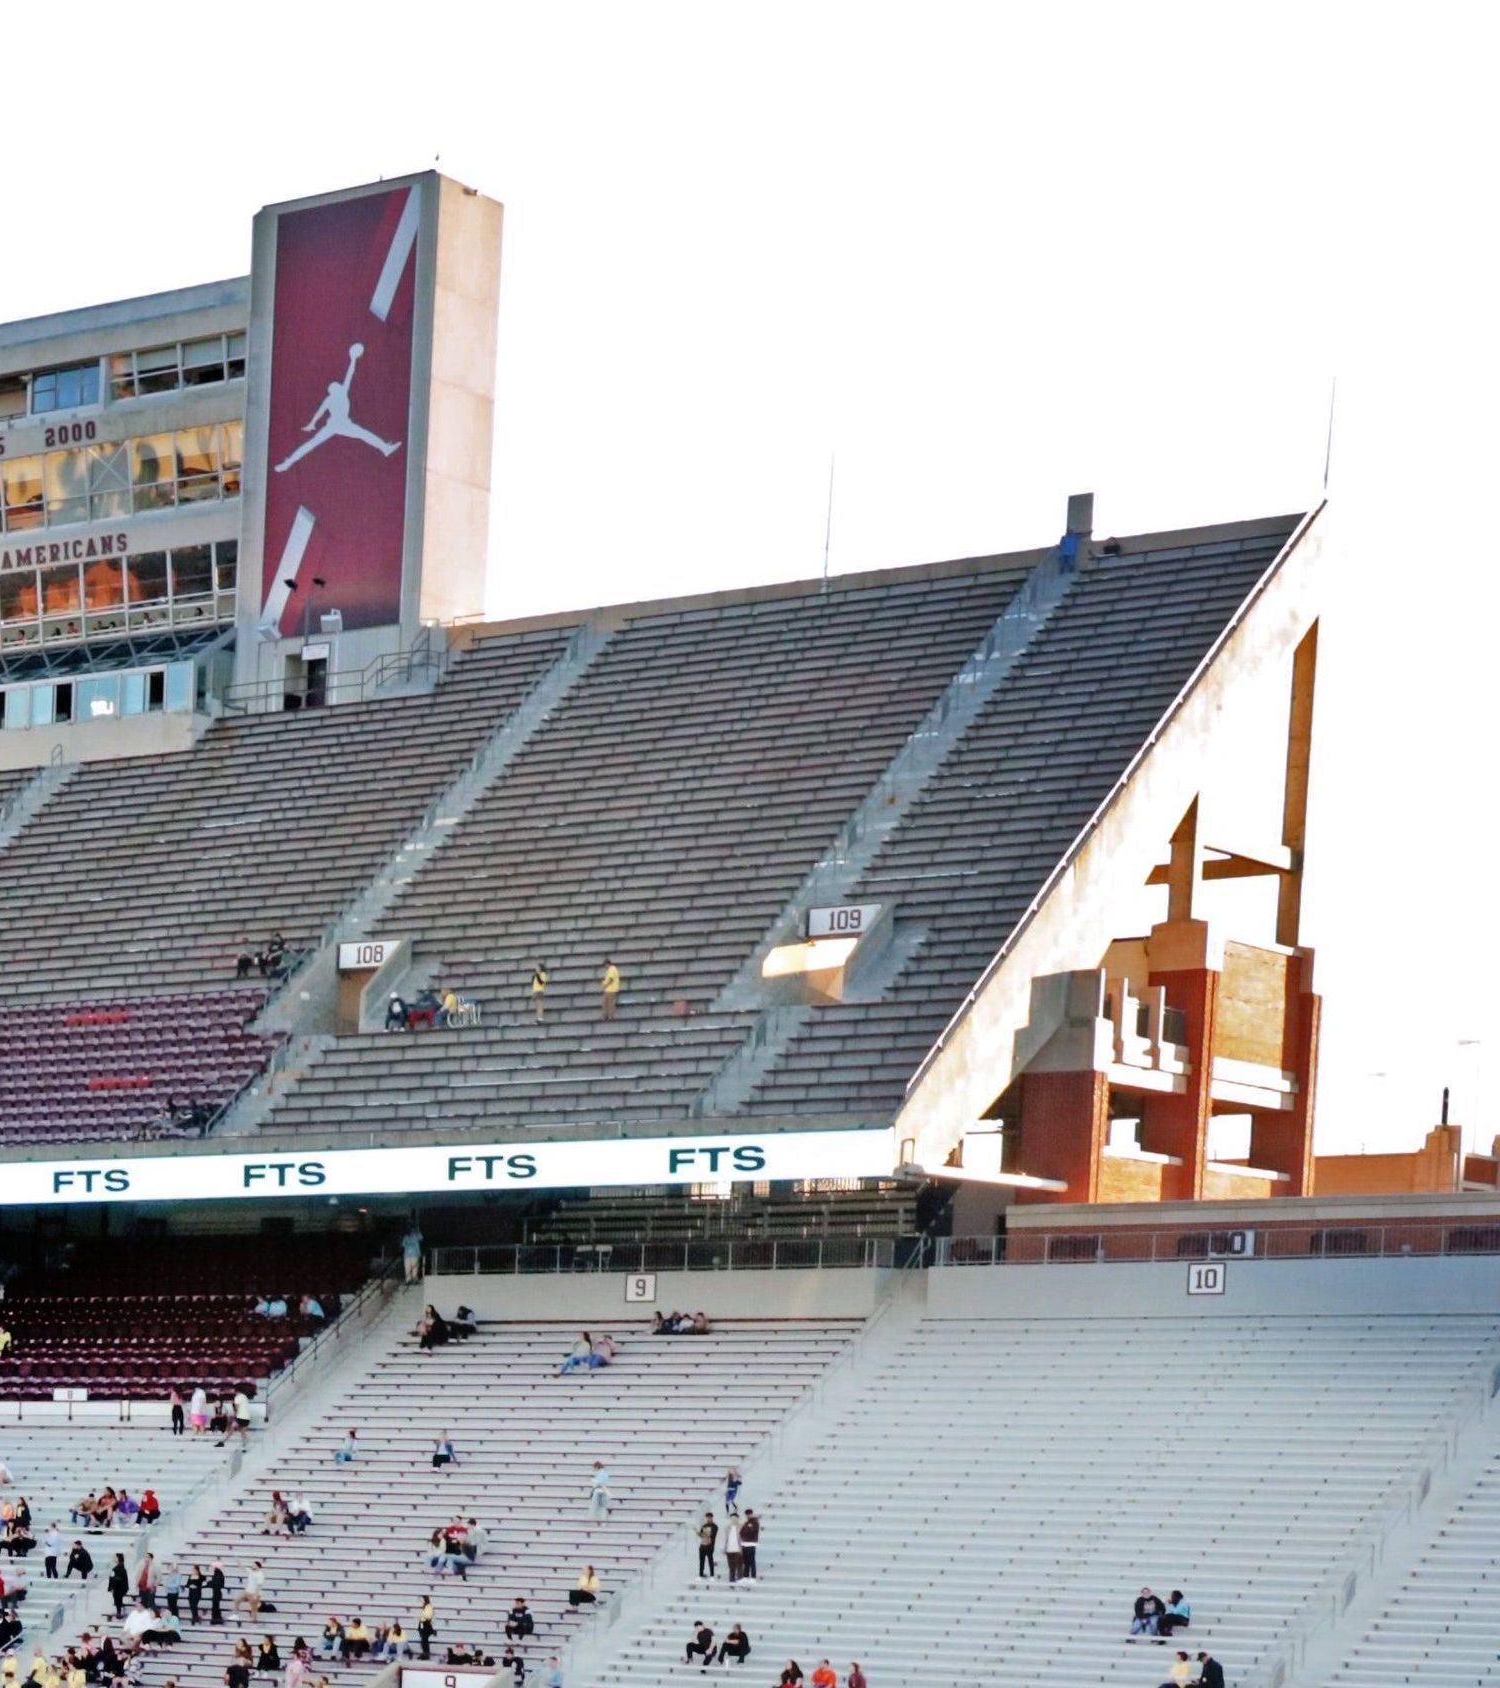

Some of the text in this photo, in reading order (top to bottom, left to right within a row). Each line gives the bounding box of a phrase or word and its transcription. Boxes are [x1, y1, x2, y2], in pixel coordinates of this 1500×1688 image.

[45, 420, 96, 448] 2000
[828, 908, 862, 932] 109
[355, 943, 384, 965] 108
[448, 1154, 537, 1181] FTS
[669, 1146, 766, 1173] FTS
[54, 1169, 130, 1193] FTS
[244, 1162, 326, 1188] FTS
[635, 1278, 646, 1297] 9
[1195, 1268, 1218, 1289] 10
